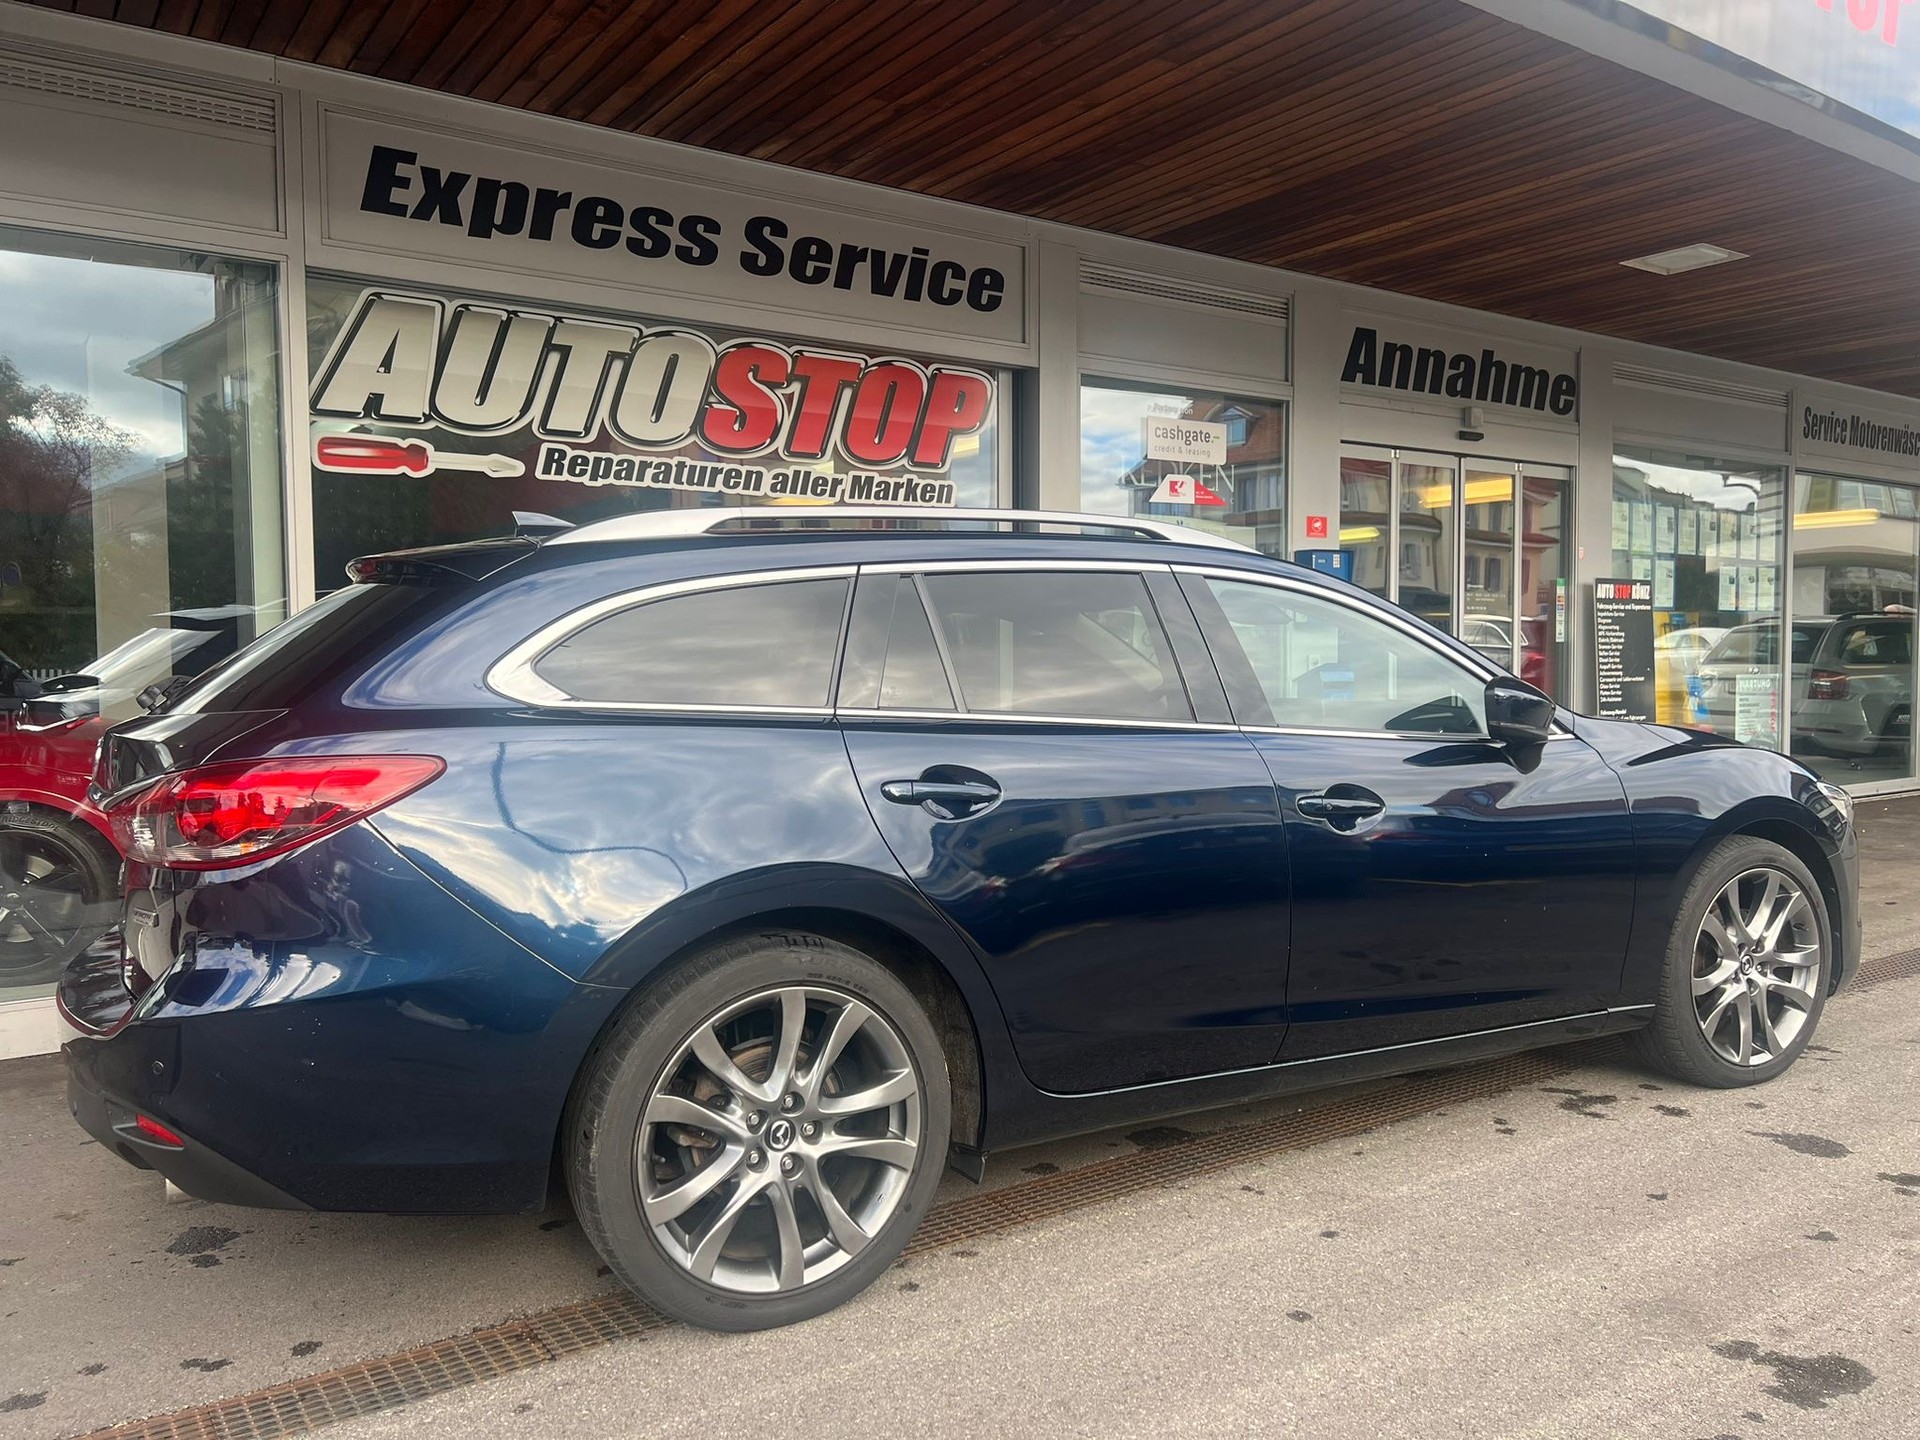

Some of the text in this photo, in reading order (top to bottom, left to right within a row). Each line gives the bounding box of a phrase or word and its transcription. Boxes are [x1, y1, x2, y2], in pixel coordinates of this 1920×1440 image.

[360, 145, 1005, 312] Express Service
[1340, 326, 1577, 416] Annahme
[1803, 406, 1848, 445] Service
[541, 447, 954, 504] Reparaturen aller Marken
[1154, 445, 1211, 458] credit & leasing
[1597, 583, 1614, 599] AUTO
[1615, 584, 1631, 599] STOP
